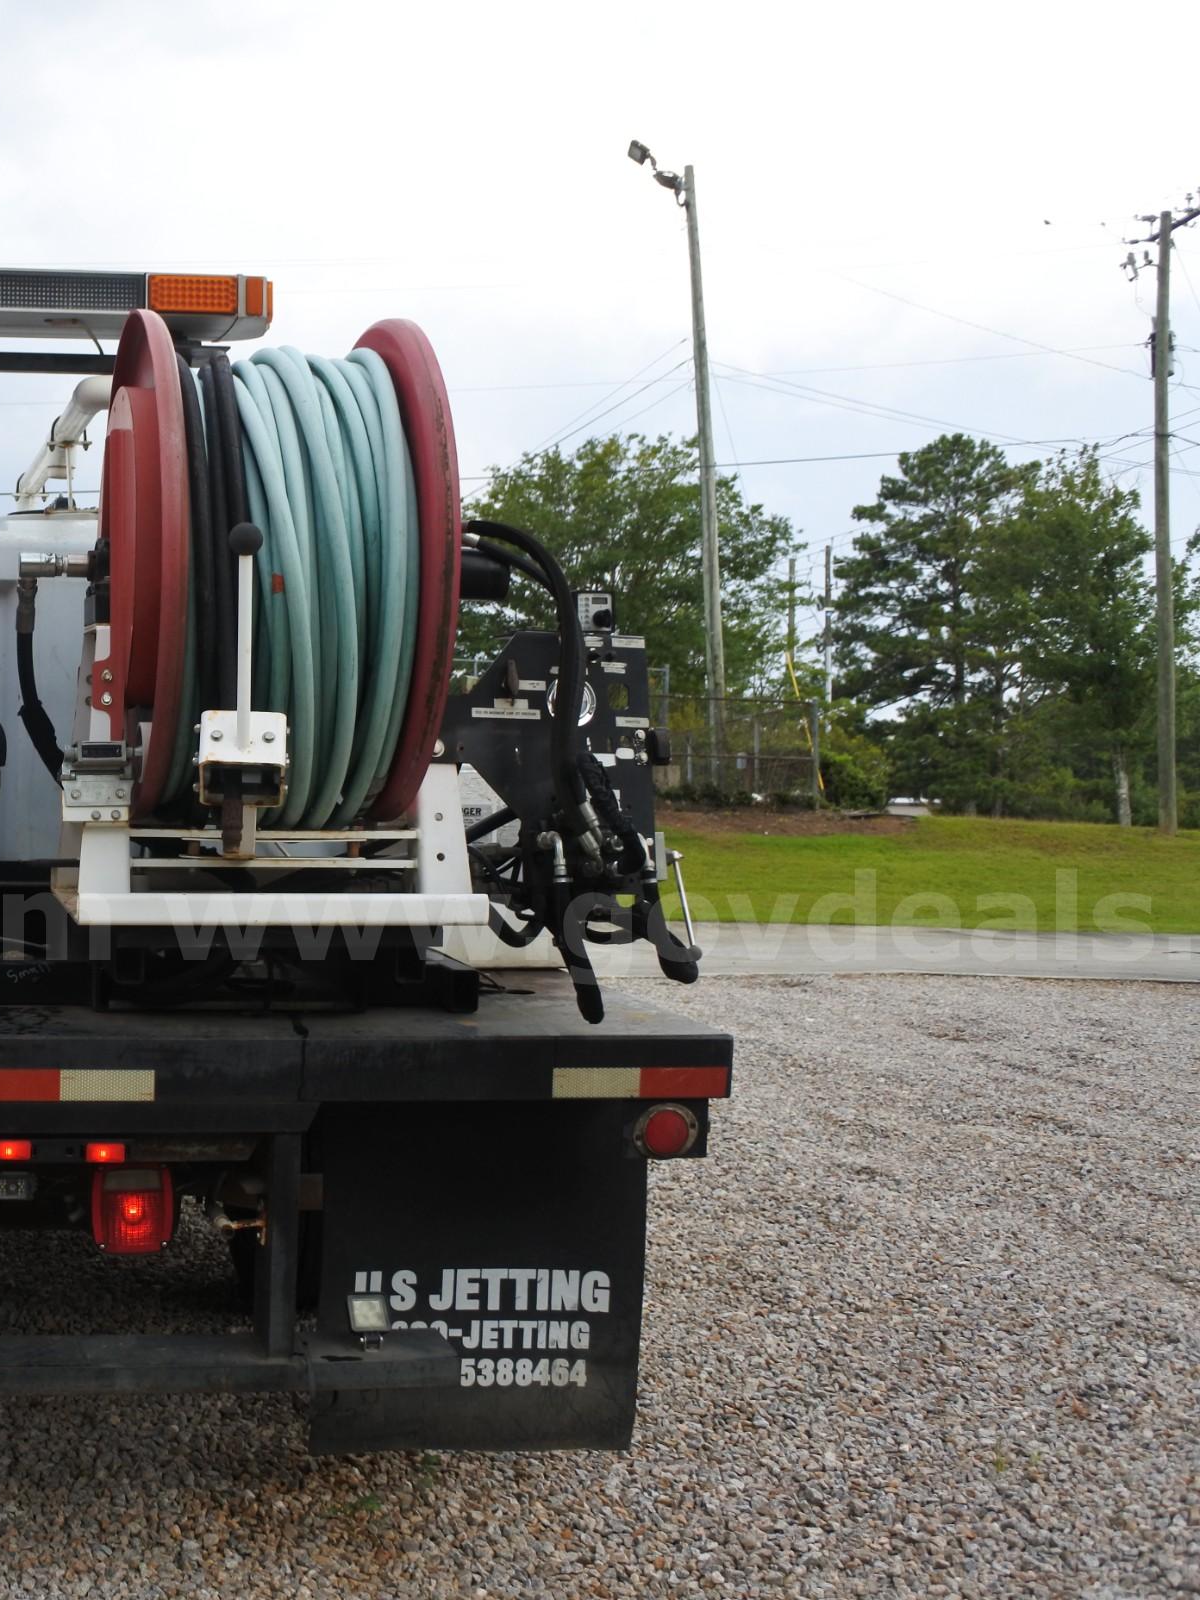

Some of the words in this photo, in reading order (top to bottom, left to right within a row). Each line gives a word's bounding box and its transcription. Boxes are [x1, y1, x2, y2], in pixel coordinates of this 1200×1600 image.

[461, 807, 482, 816] GER
[390, 1269, 418, 1311] S
[429, 1268, 611, 1313] JETTING
[460, 1358, 587, 1387] 5388464
